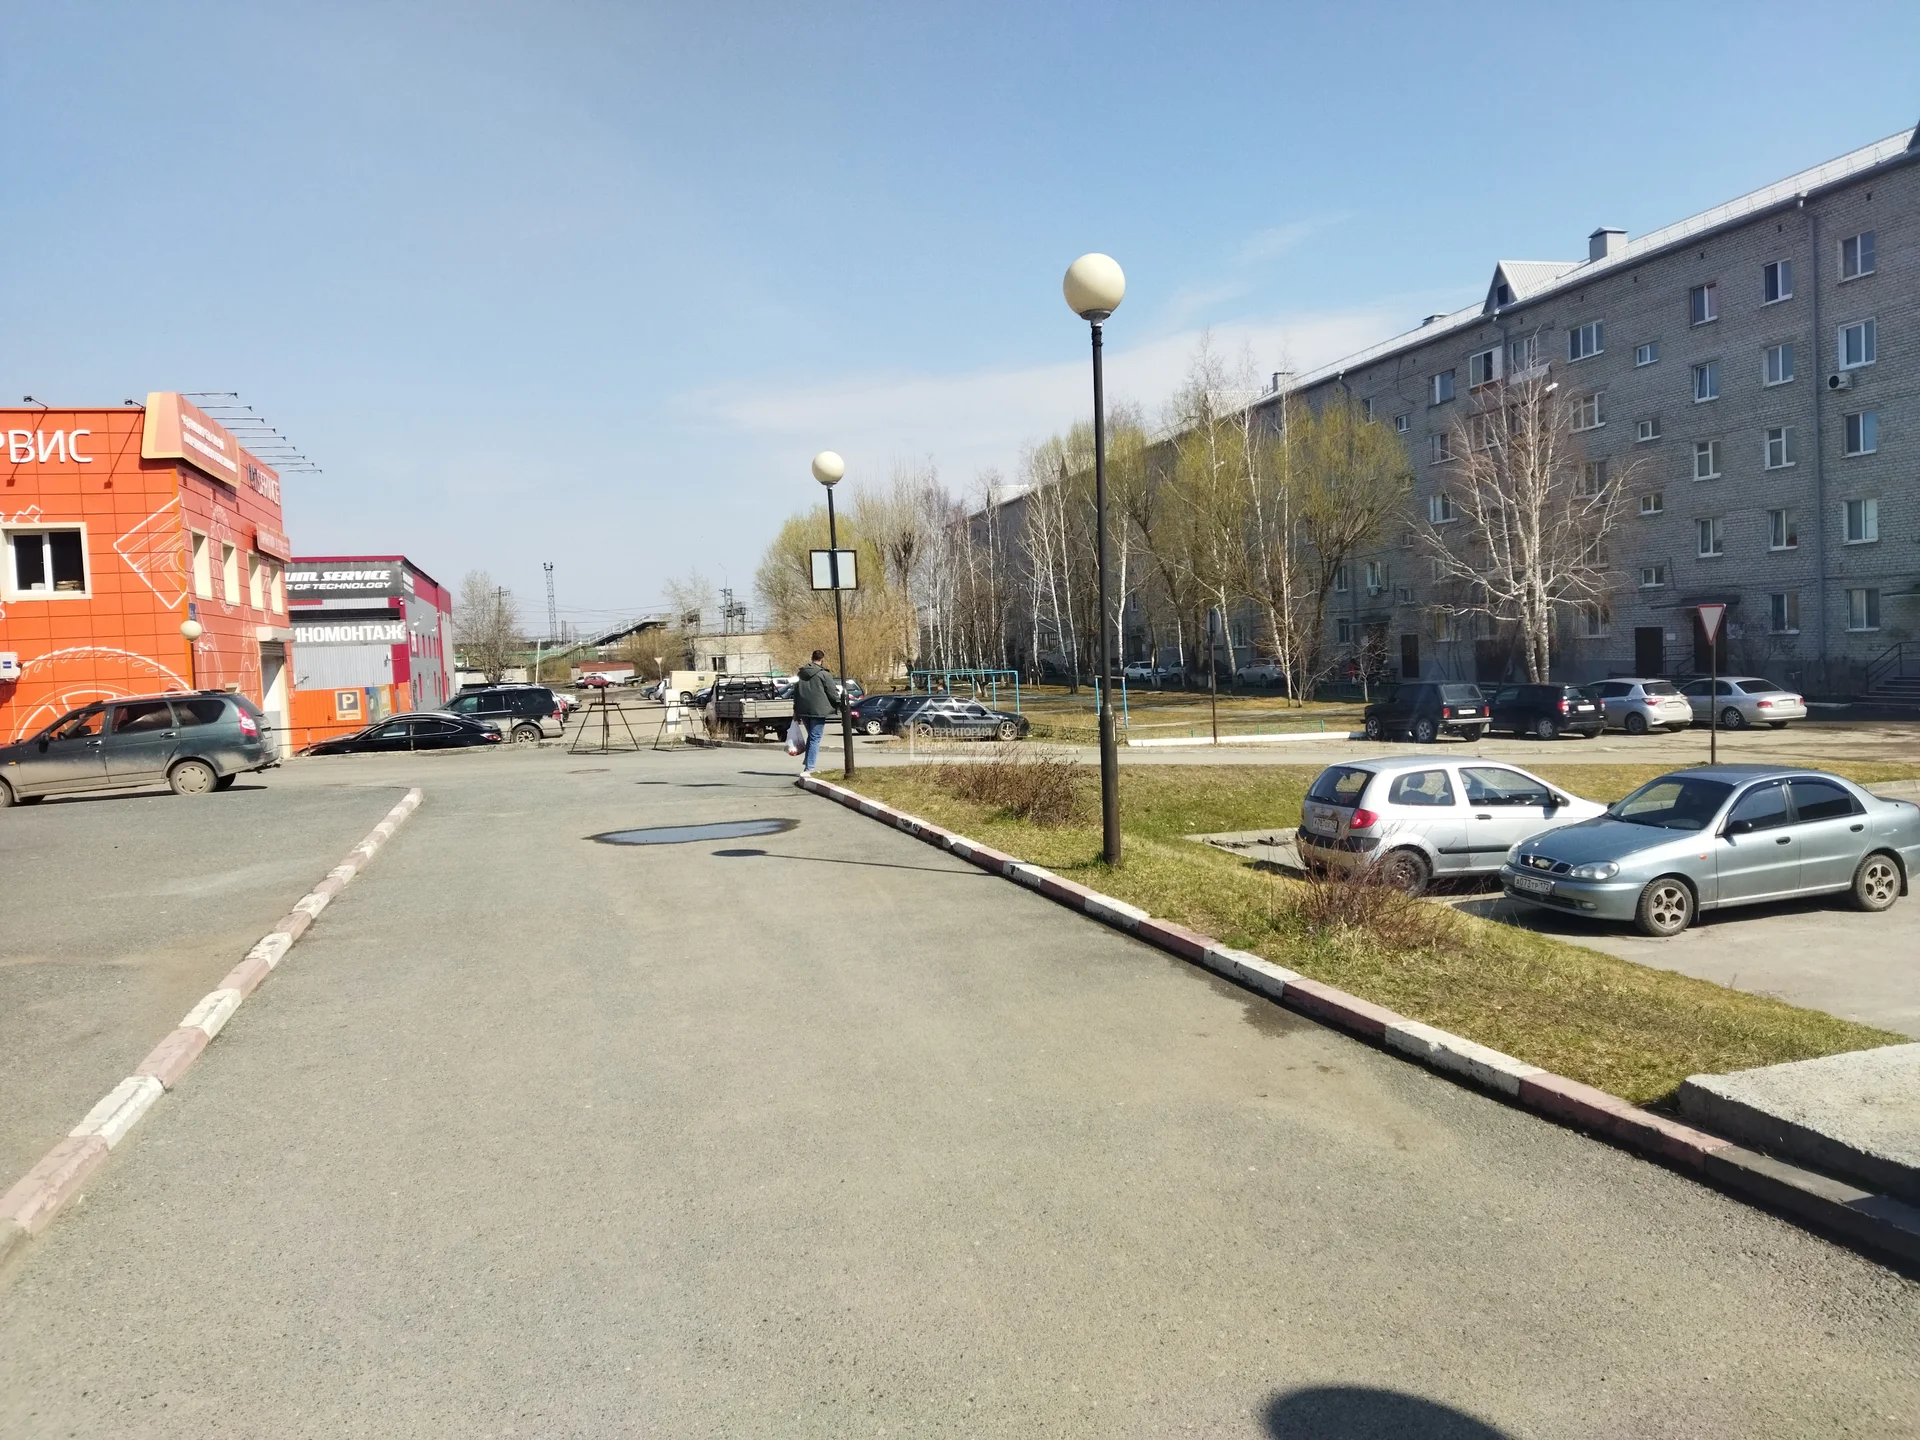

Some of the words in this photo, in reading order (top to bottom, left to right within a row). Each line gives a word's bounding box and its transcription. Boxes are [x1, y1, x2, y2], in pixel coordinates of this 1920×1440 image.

[0, 430, 93, 464] ВИС
[321, 570, 392, 581] SERVICE
[294, 583, 311, 591] OF
[312, 581, 392, 590] TECHNOLOGY
[342, 694, 354, 709] P
